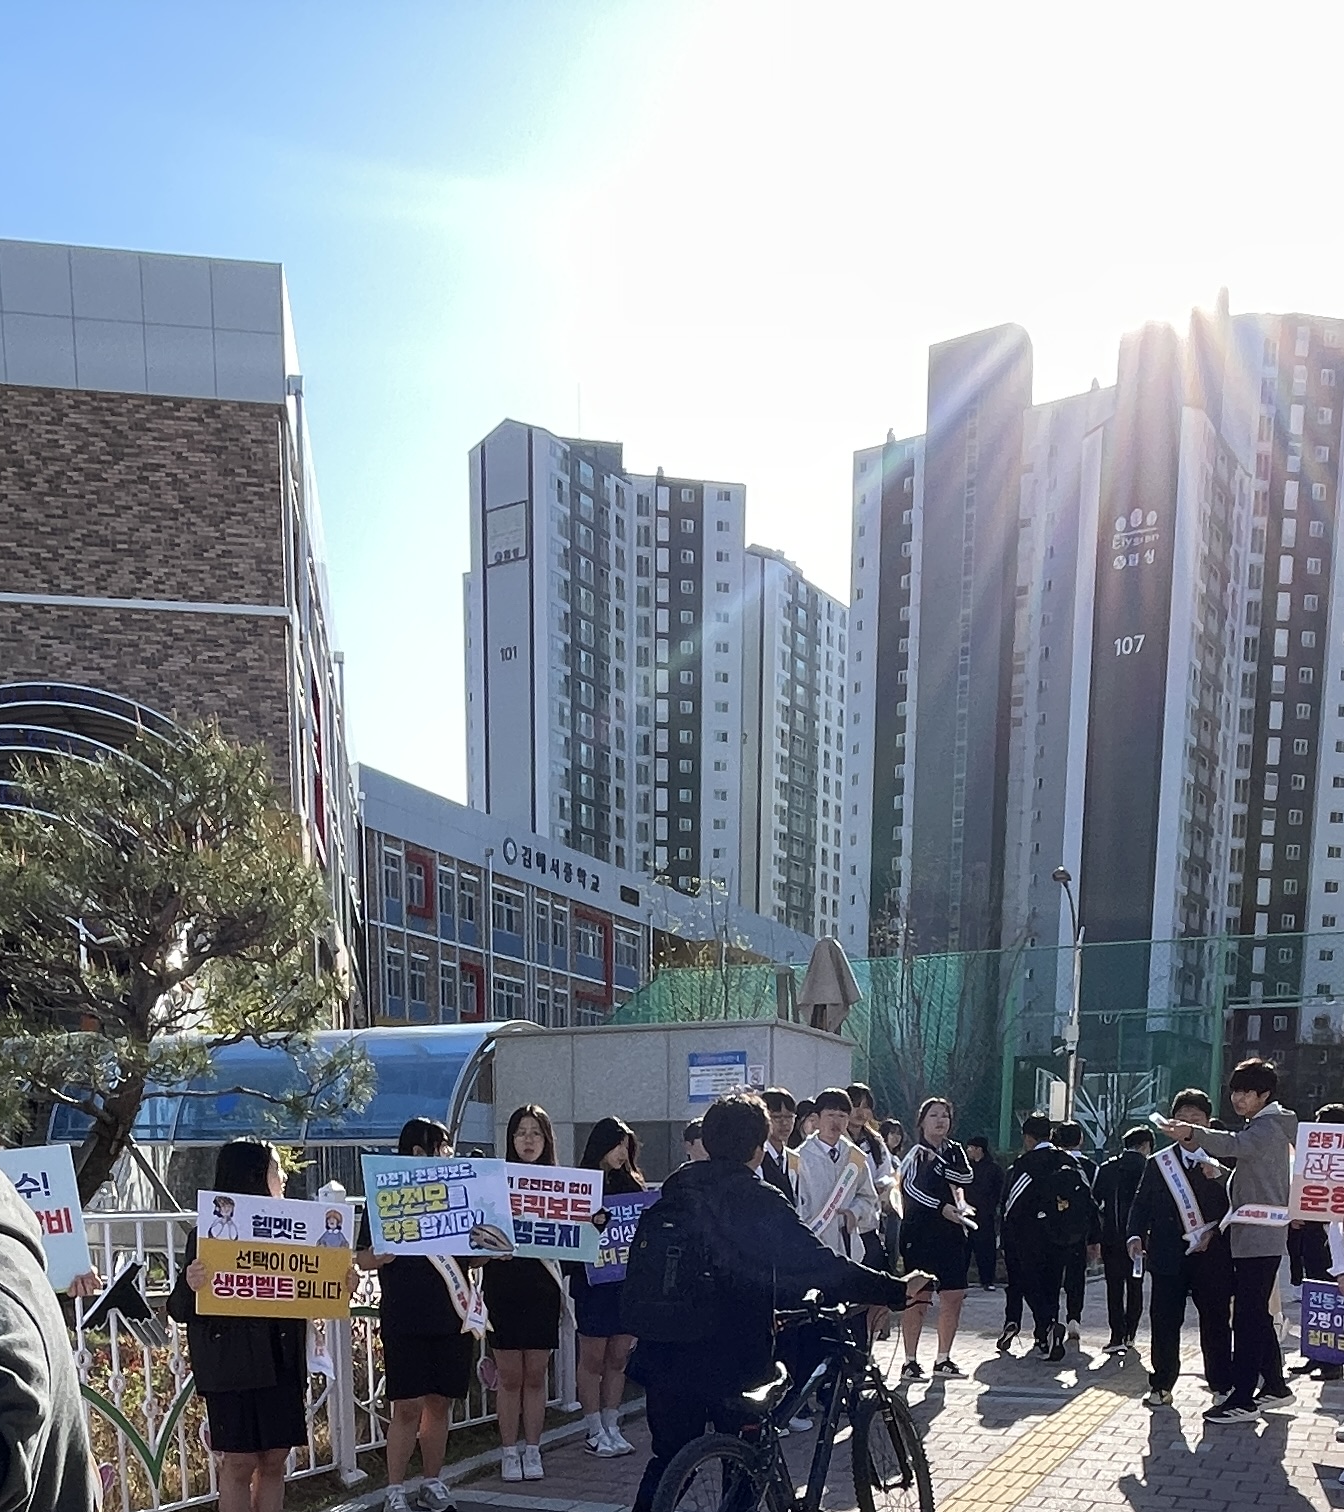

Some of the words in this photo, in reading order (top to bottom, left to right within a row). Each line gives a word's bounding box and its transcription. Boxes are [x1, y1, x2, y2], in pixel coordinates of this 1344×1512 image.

[500, 645, 518, 662] 101
[1114, 634, 1146, 656] 107
[521, 846, 600, 893] 김해서중학교
[518, 1177, 565, 1193] 운전면허
[568, 1181, 592, 1196] 없이
[376, 1183, 468, 1219] 안전모를
[251, 1214, 307, 1240] 헬멧은
[381, 1209, 485, 1244] 착용합시다!
[236, 1250, 285, 1272] 선택이
[289, 1253, 319, 1274] 아닌
[1308, 1311, 1331, 1329] 2명
